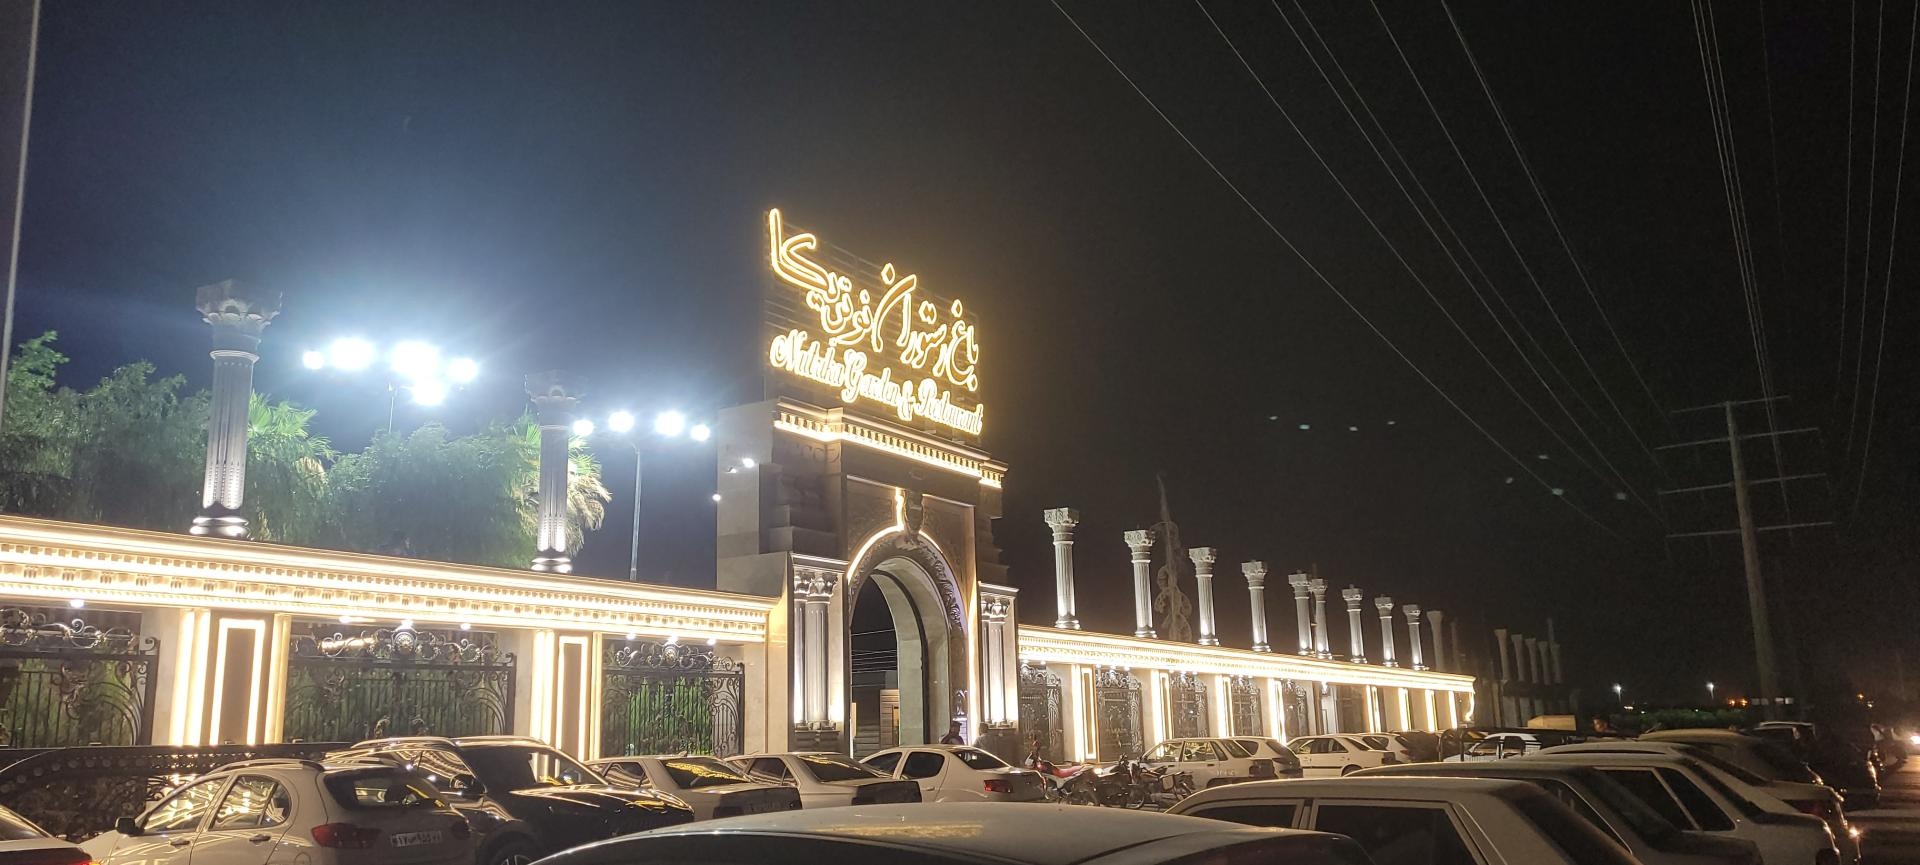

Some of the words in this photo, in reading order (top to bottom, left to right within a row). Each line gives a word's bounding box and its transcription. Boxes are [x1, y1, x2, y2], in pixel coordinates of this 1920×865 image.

[871, 262, 951, 378] رستوران
[947, 299, 979, 392] باغ
[841, 348, 902, 403] Garden
[897, 379, 917, 421] &
[915, 377, 984, 435] Restaurant
